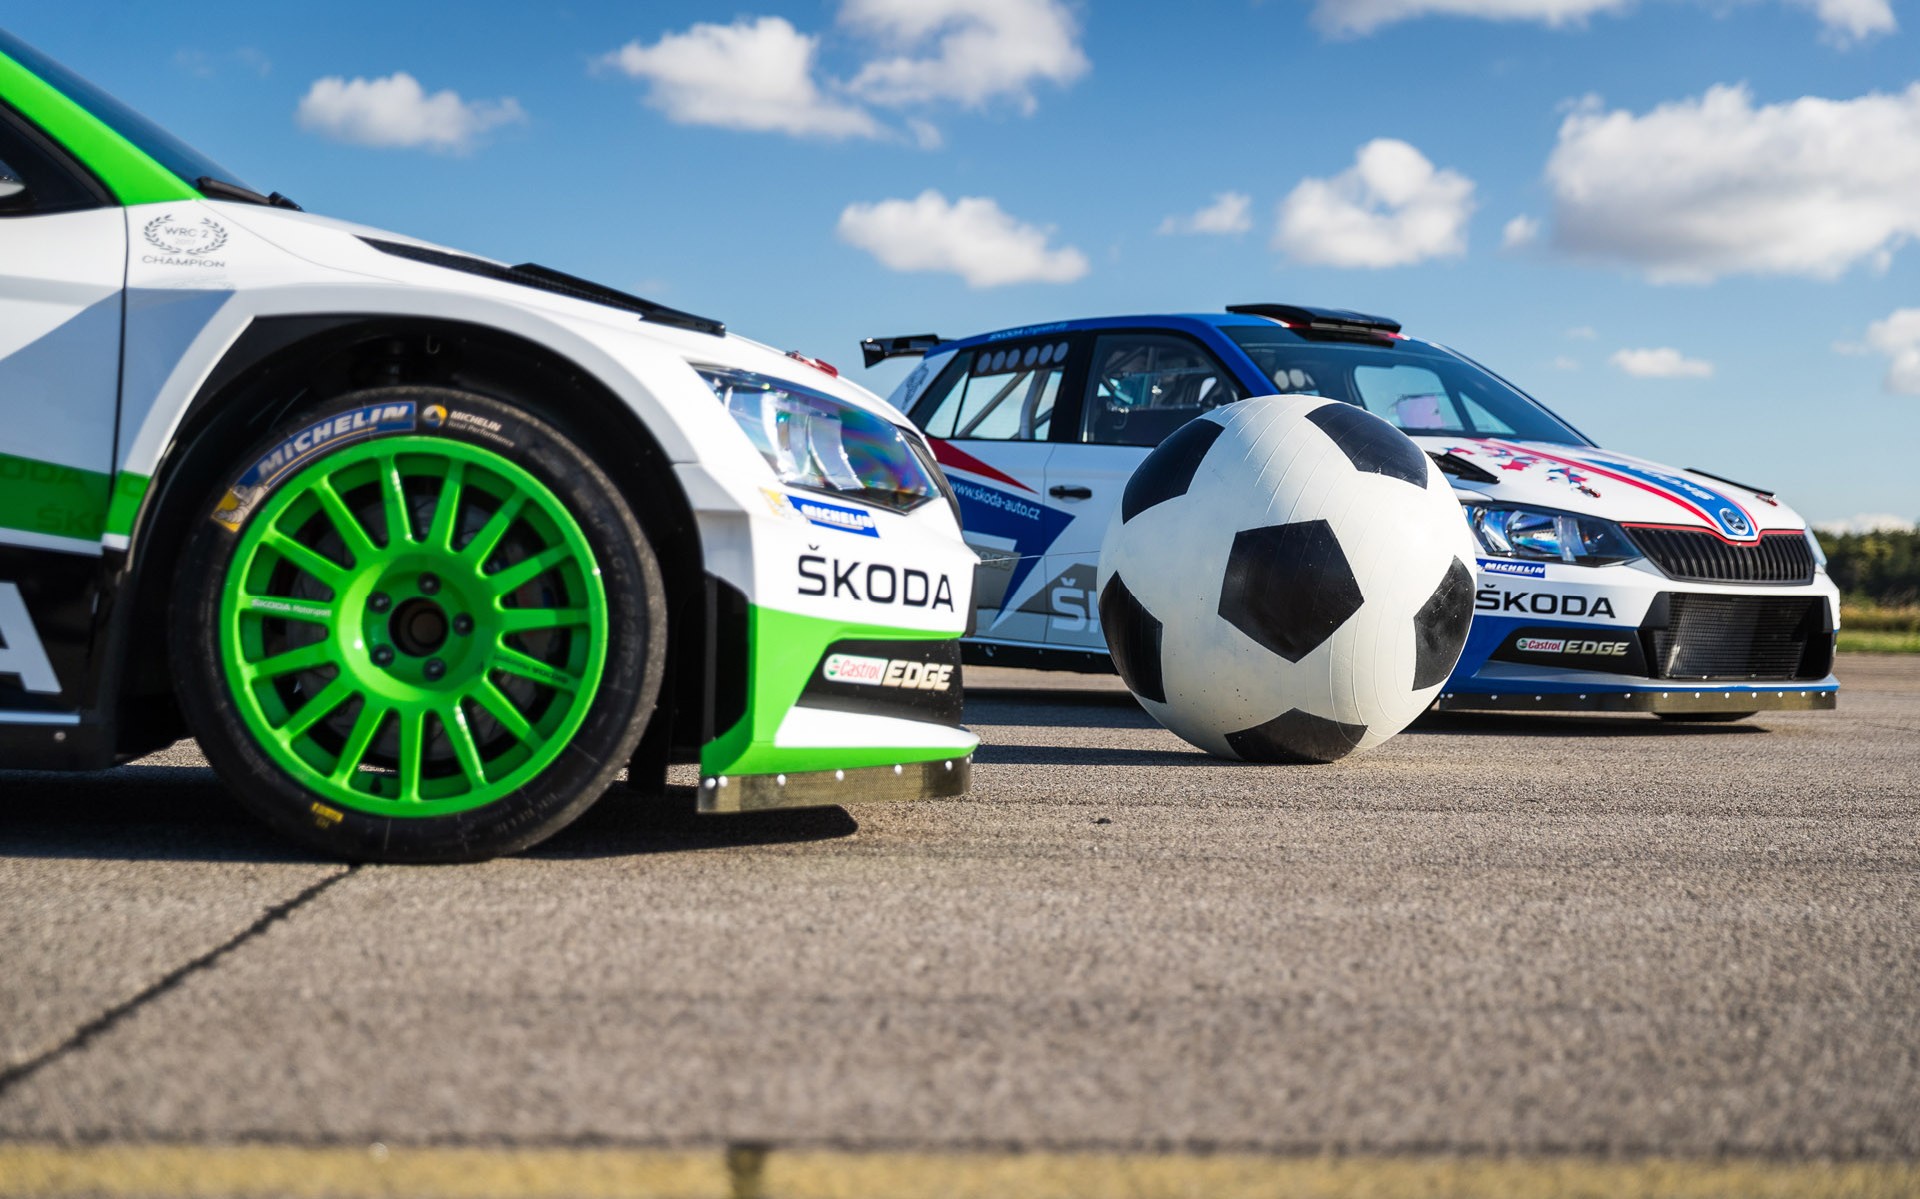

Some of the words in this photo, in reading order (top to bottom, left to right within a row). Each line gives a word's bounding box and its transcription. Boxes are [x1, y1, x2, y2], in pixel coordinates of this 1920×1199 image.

[164, 226, 198, 237] WRC
[201, 229, 209, 238] 2
[142, 255, 225, 267] CHAMPION
[450, 410, 502, 432] MICHELIN
[257, 405, 409, 477] MICHELIN
[949, 480, 1041, 520] www.skoda-auto.cz
[800, 504, 875, 528] MICHELIN
[798, 544, 954, 613] ŠKODA
[1484, 562, 1546, 575] MICHELIN
[1475, 584, 1617, 619] ŠKODA
[1527, 640, 1562, 651] Castrol
[1564, 640, 1630, 656] EDGE
[840, 659, 880, 679] Castrol
[882, 659, 954, 691] EDGE
